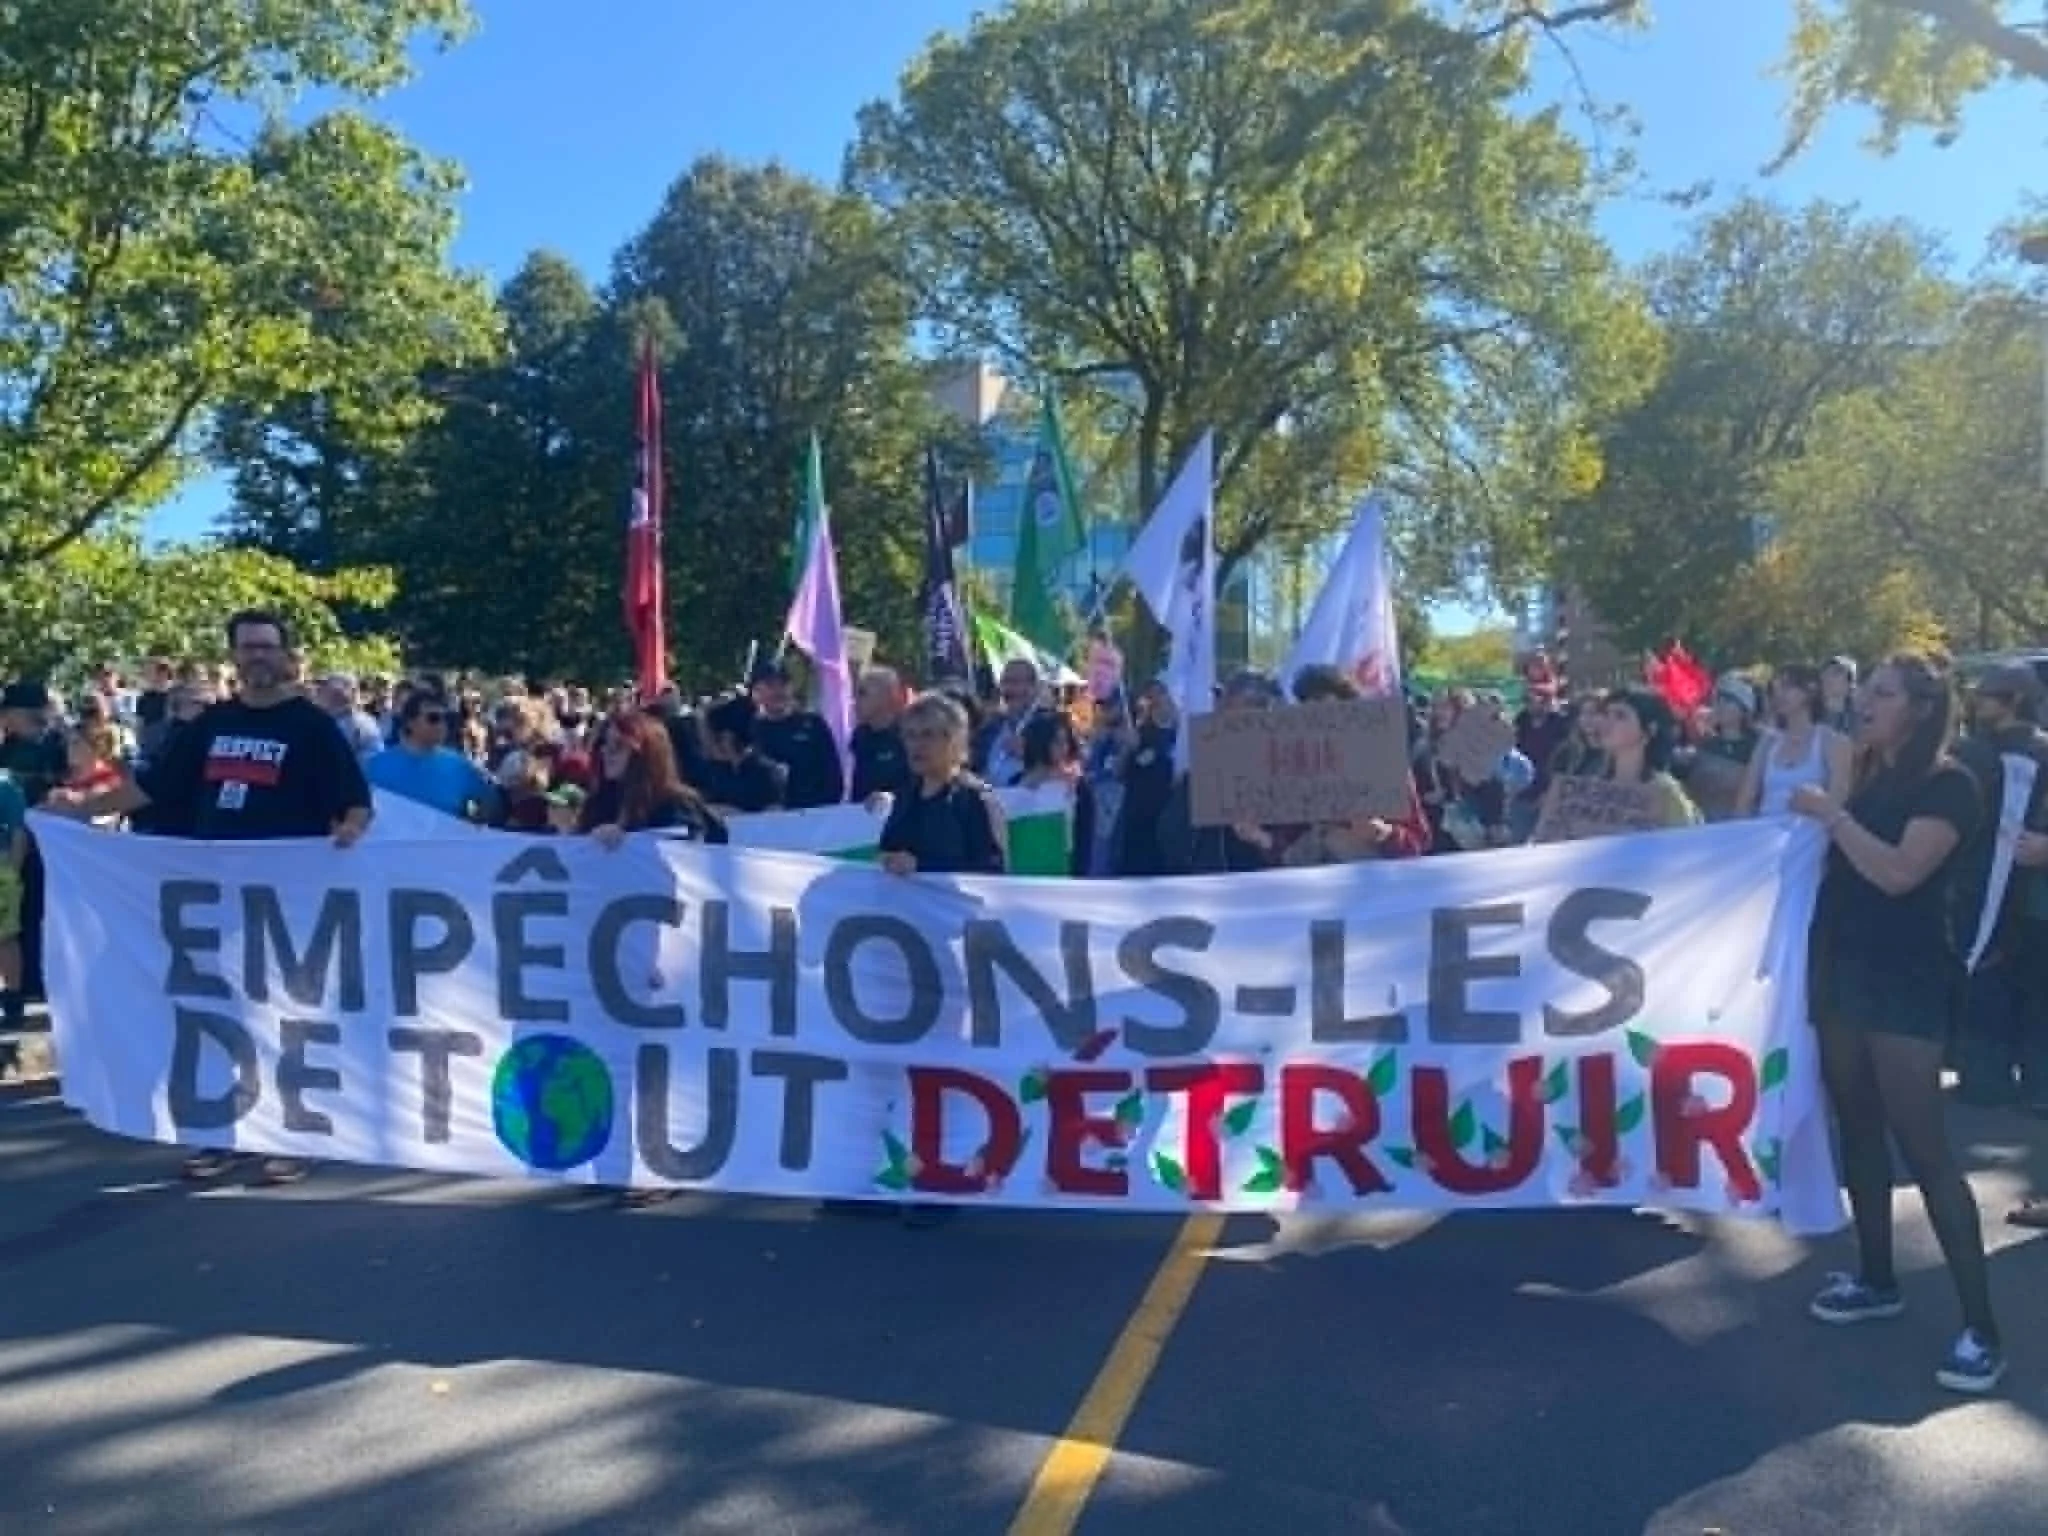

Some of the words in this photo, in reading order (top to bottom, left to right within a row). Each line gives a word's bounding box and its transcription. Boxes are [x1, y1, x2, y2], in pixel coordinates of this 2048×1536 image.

[158, 846, 1653, 1057] EMPÊCHONS-LES
[166, 1005, 341, 1135] DE
[906, 1029, 1763, 1203] DÉTRUIR
